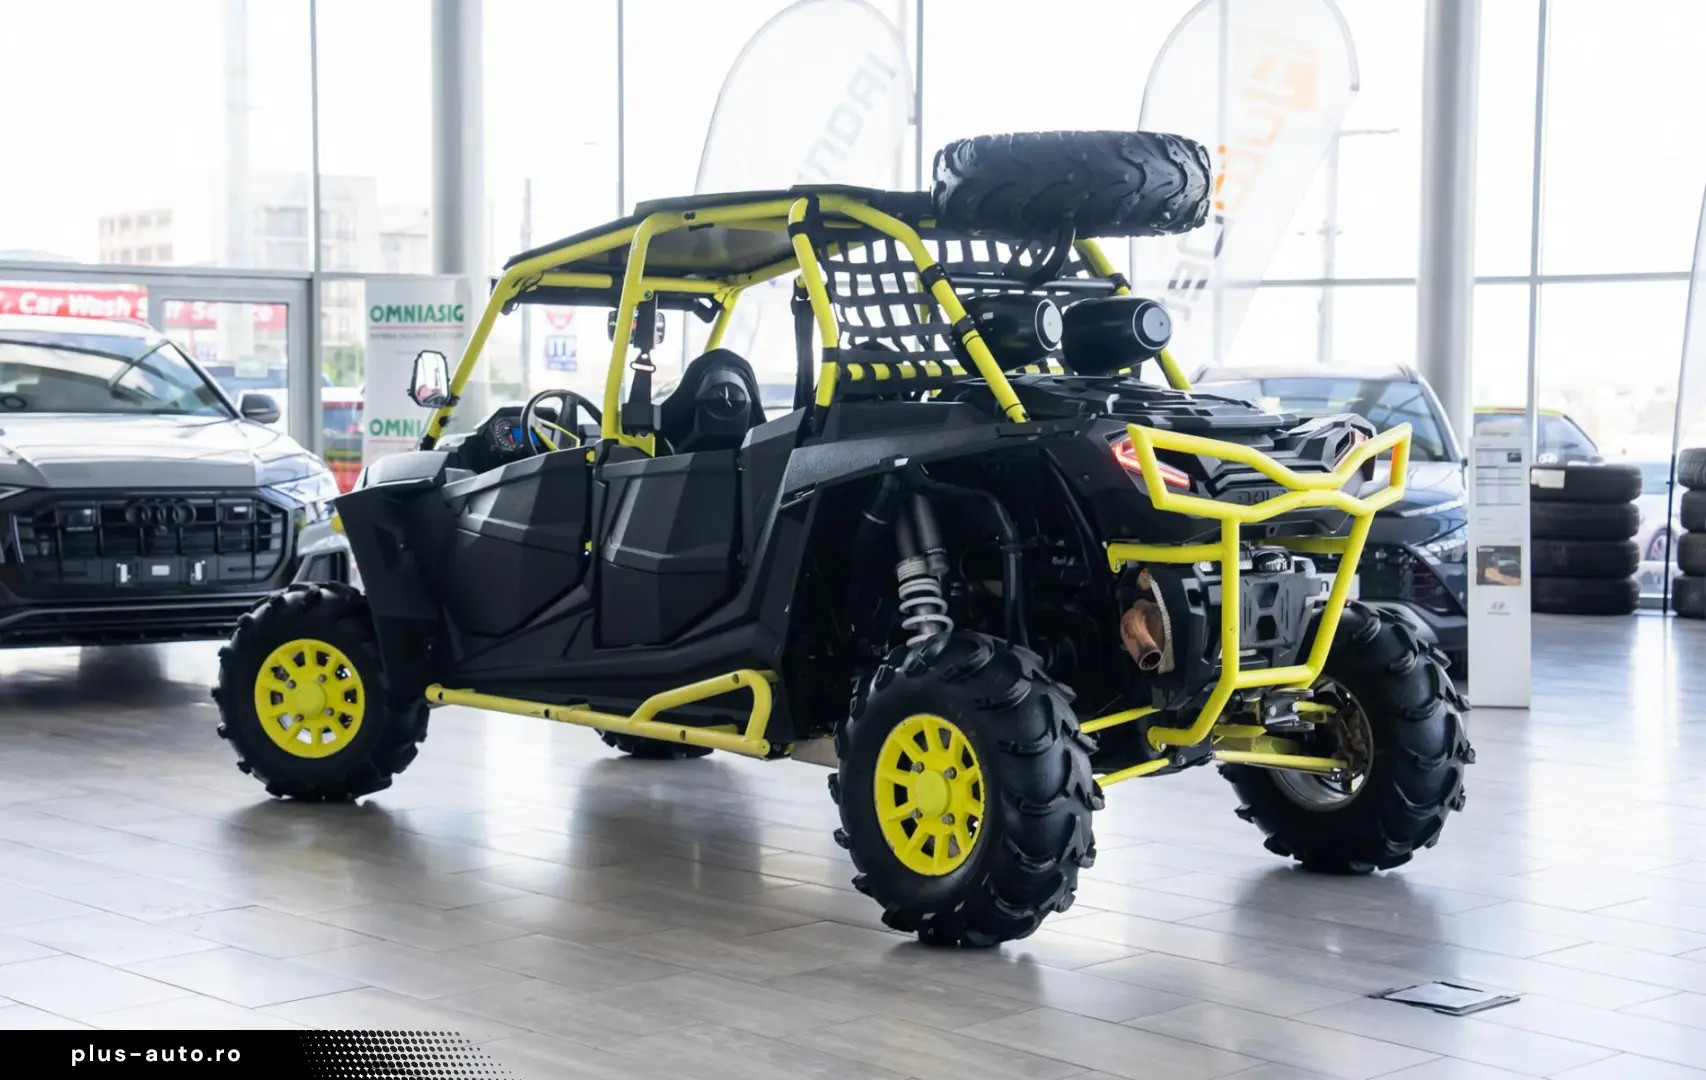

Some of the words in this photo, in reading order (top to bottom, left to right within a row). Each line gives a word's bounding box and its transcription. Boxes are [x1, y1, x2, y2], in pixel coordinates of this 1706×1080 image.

[19, 291, 64, 314] Car
[68, 293, 132, 318] Wash
[370, 304, 465, 323] OMNIASIG
[369, 418, 424, 437] OMNI
